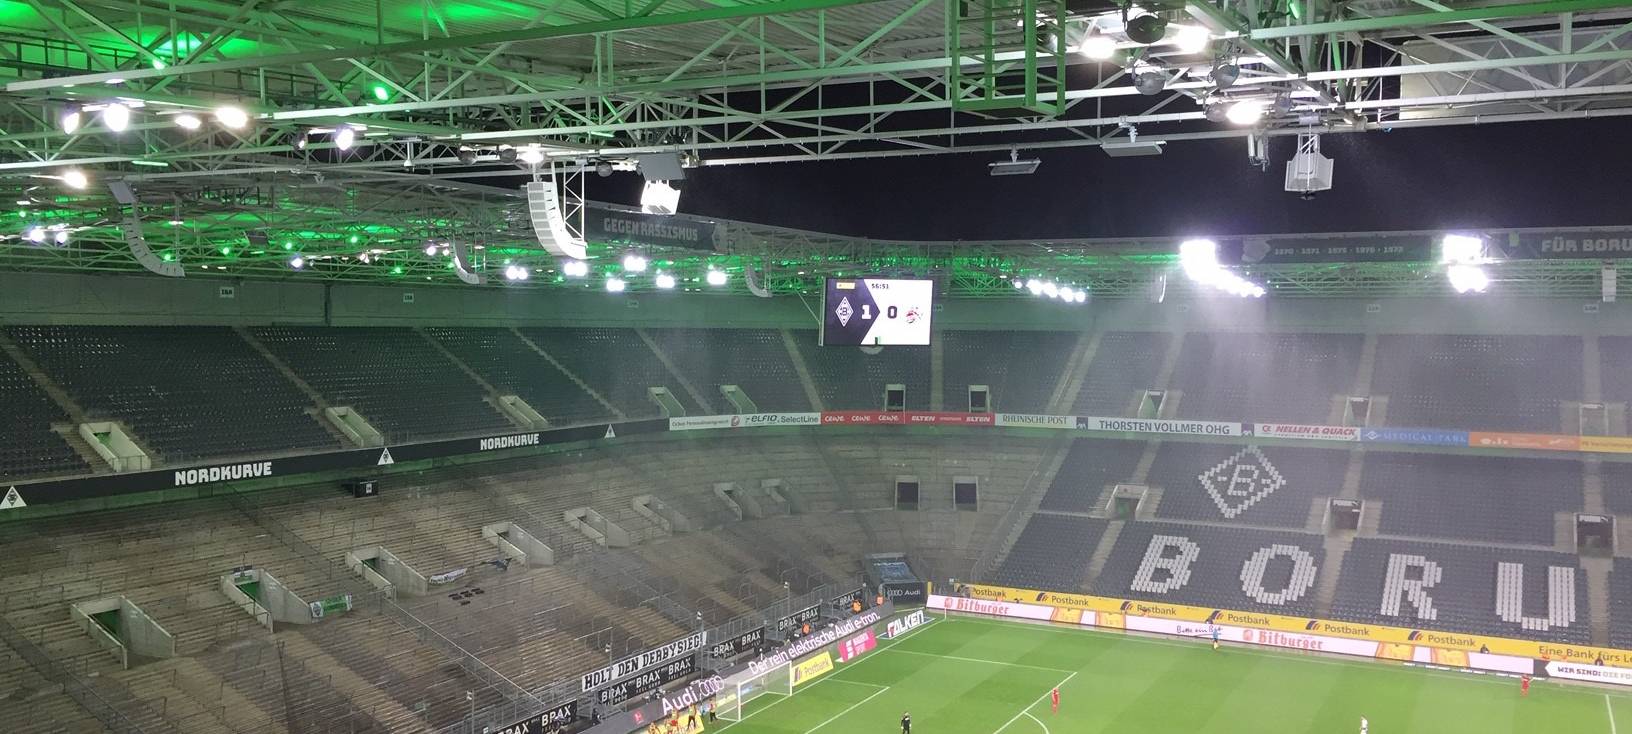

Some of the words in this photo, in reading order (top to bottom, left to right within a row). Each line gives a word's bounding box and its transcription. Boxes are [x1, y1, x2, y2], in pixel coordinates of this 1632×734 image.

[604, 217, 639, 235] GEGEN
[641, 222, 698, 241] RASSISMUS
[1541, 236, 1578, 252] FÜR
[1582, 238, 1632, 251] BORU
[861, 304, 872, 320] 1
[887, 305, 898, 319] 0
[780, 415, 819, 423] SelectLine
[1002, 414, 1046, 425] RHEINISCHE
[1047, 416, 1068, 425] POST
[1099, 420, 1152, 431] THORSTEN
[1153, 422, 1204, 433] VOLLMER
[1205, 424, 1231, 434] OHG
[1275, 425, 1313, 434] NELLEN
[1321, 427, 1356, 436] QUACK
[480, 433, 540, 451] NORDKURVE
[174, 461, 273, 486] NORDKURVE
[838, 592, 855, 607] BRAX
[1051, 595, 1090, 607] Postbank
[956, 600, 1010, 616] Bitburger
[1136, 604, 1178, 617] Postbank
[779, 615, 798, 632] BRAX
[801, 606, 819, 622] BRAX
[887, 609, 926, 638] FALKEN
[1227, 613, 1271, 627] Postbank
[1208, 625, 1223, 634] Bt
[1323, 623, 1371, 637] Postbank
[713, 640, 736, 658] BRAX
[741, 630, 762, 647] BRAX
[748, 658, 769, 676] Der
[769, 649, 789, 668] rein
[789, 628, 836, 659] elektrische
[835, 616, 855, 641] Audi
[854, 611, 881, 629] e-tron.
[1258, 630, 1324, 650] Bitburger
[1427, 634, 1477, 648] Postbank
[1538, 645, 1563, 657] Eine
[1566, 649, 1595, 660] Bank
[584, 666, 614, 690] HOLT
[618, 657, 639, 677] DEN
[601, 682, 629, 703] BRAX
[635, 669, 661, 689] BRAX
[668, 656, 692, 675] BRAX
[1557, 666, 1575, 675] WIR
[1576, 668, 1602, 677] SIND:
[1602, 671, 1619, 679] DIE
[661, 686, 699, 716] Audi
[541, 704, 572, 727] BRAX
